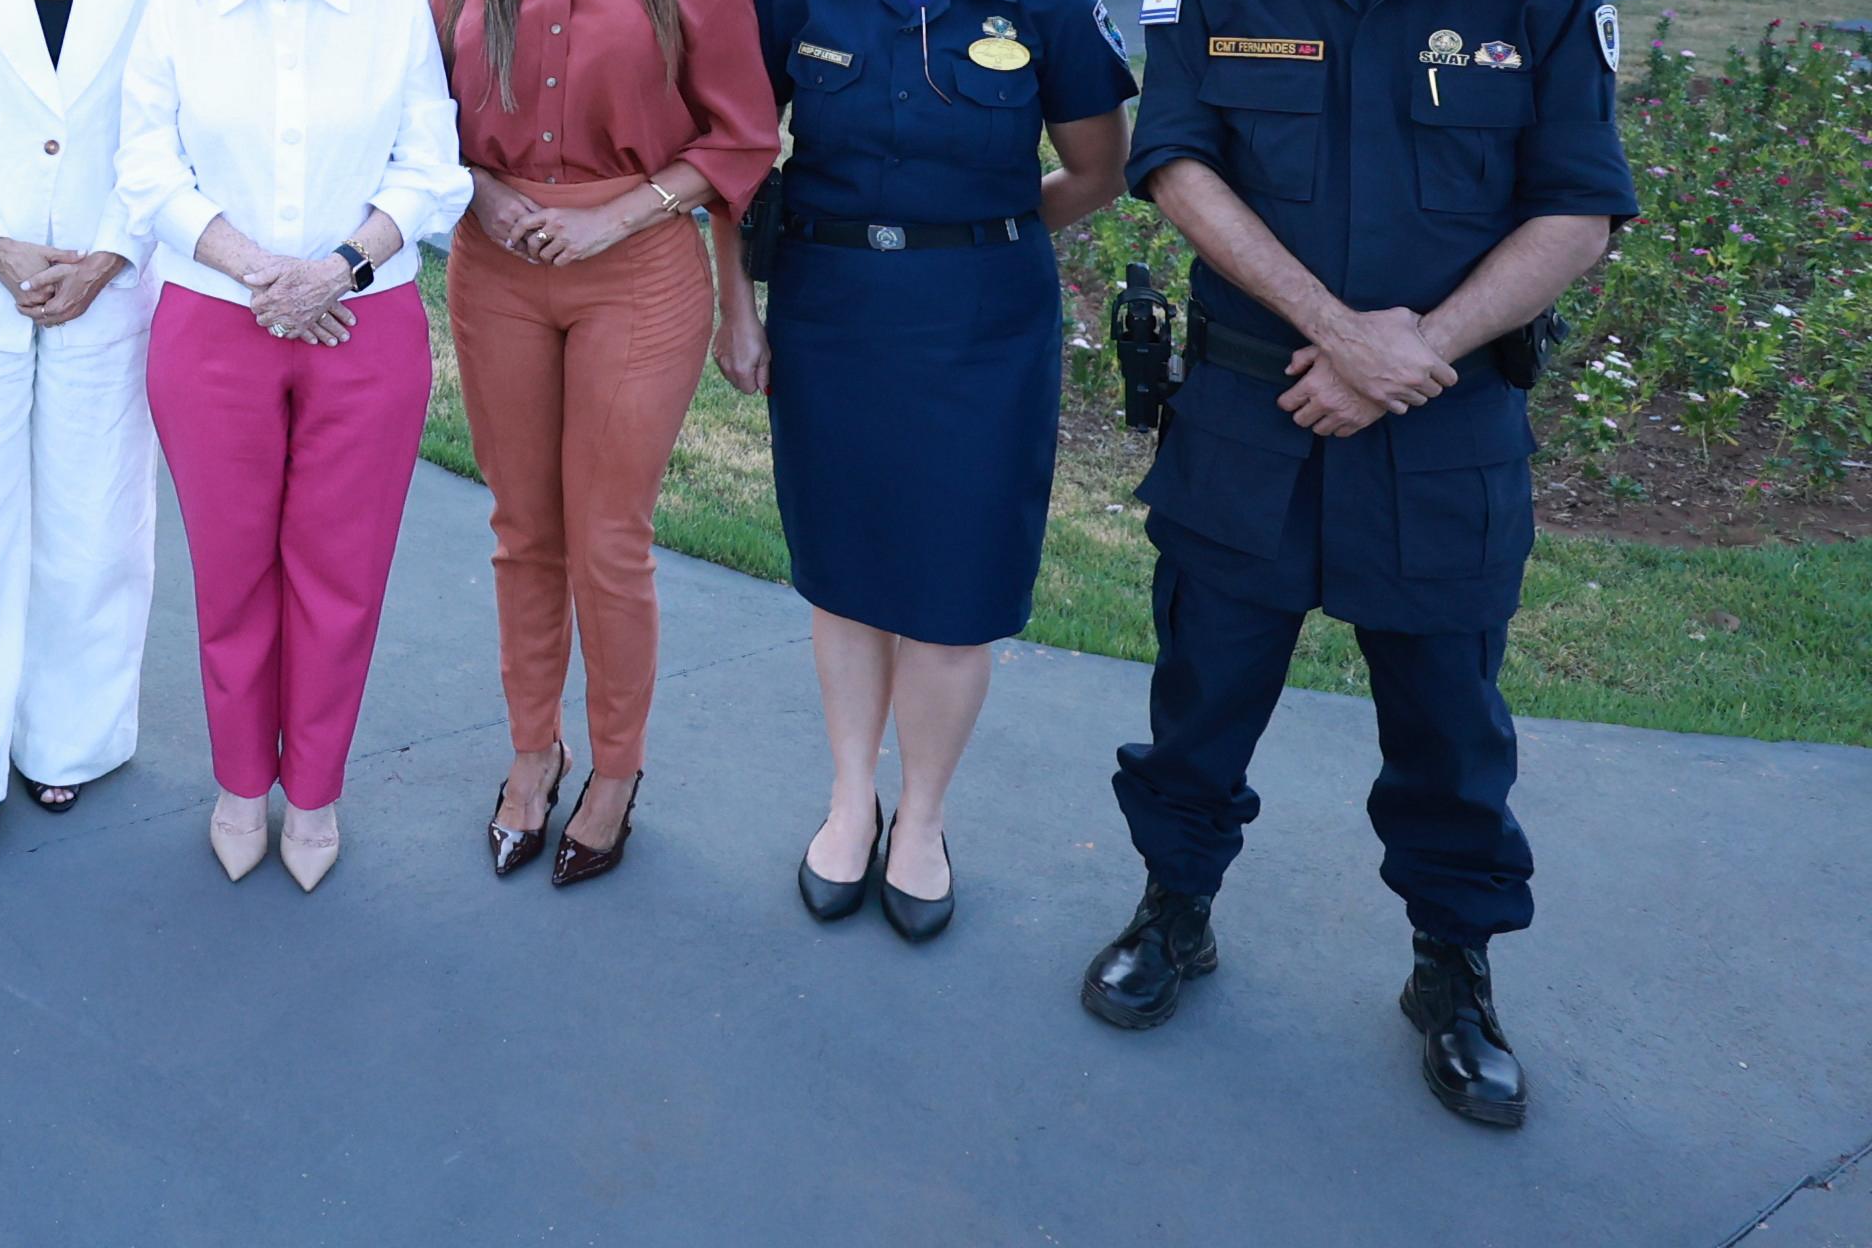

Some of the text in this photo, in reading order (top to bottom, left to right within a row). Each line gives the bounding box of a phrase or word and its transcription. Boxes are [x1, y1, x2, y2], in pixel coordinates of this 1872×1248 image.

[1215, 41, 1236, 52] CMT
[1238, 42, 1296, 54] FERNANDES
[1420, 51, 1469, 65] SWAT
